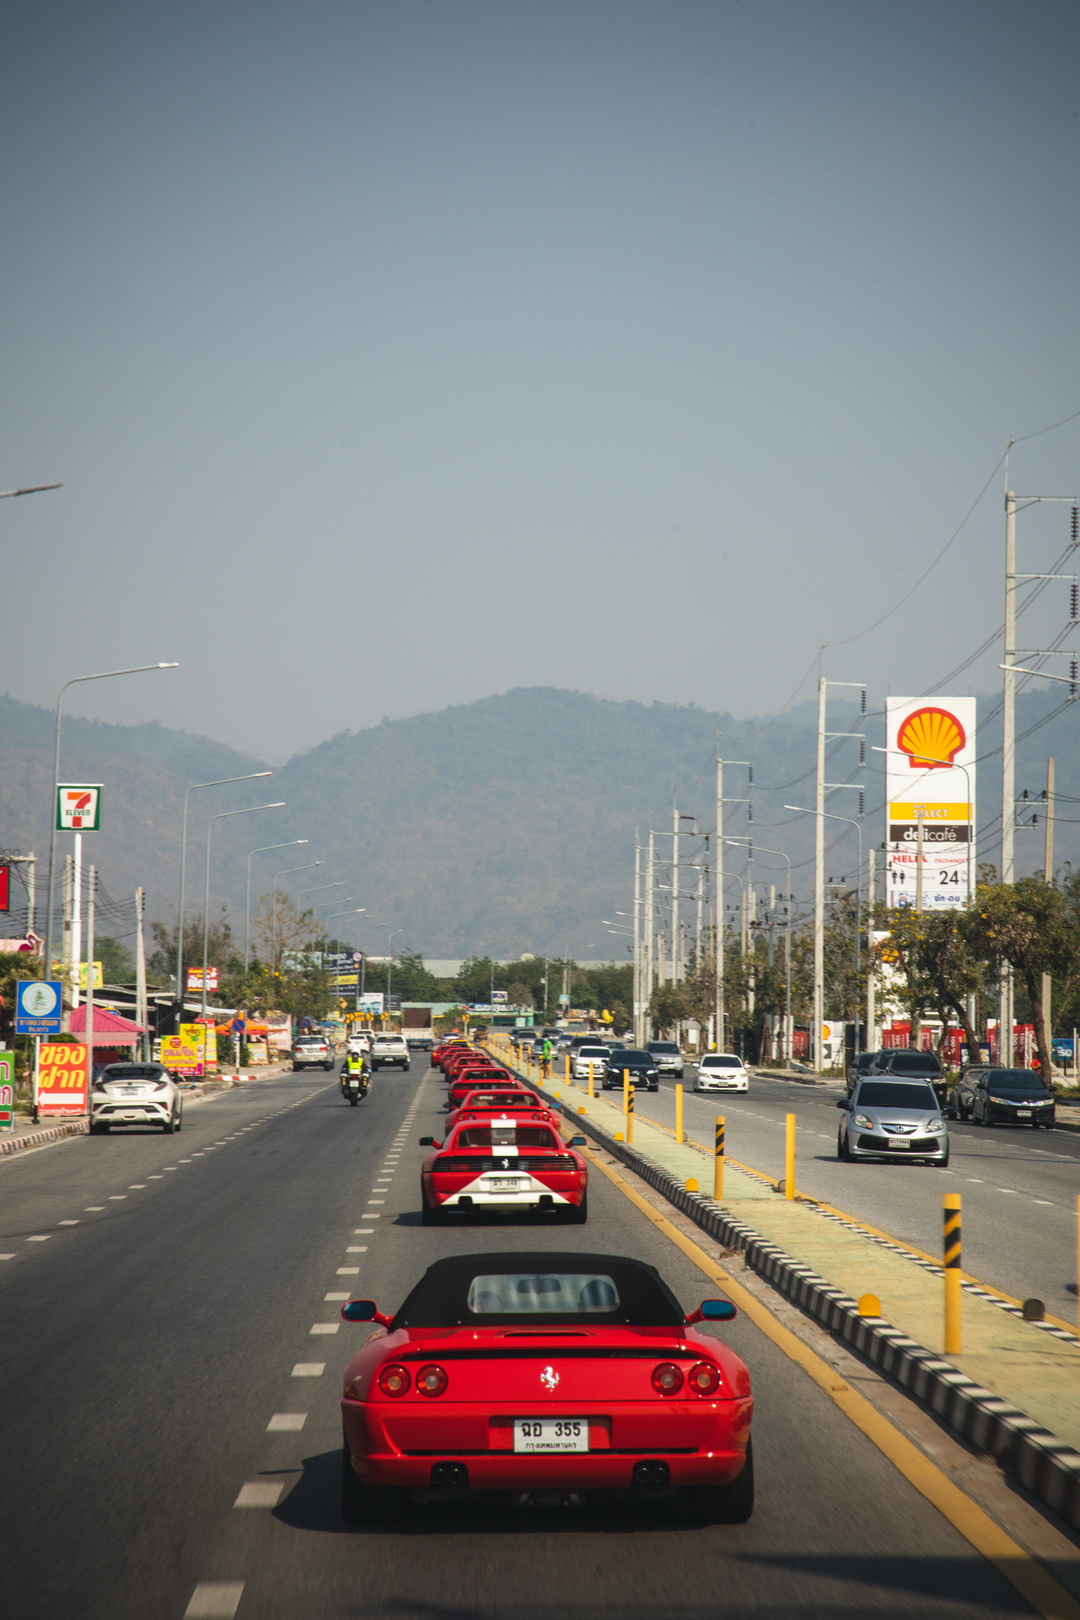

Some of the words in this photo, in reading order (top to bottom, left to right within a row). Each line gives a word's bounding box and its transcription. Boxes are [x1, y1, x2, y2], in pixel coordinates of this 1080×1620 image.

[67, 792, 91, 827] 7
[913, 809, 949, 818] SELECT
[939, 870, 959, 885] 24
[39, 1046, 87, 1065] ของ
[38, 1066, 86, 1088] ฝาก
[521, 1422, 542, 1437] ฉอ
[555, 1422, 581, 1437] 355
